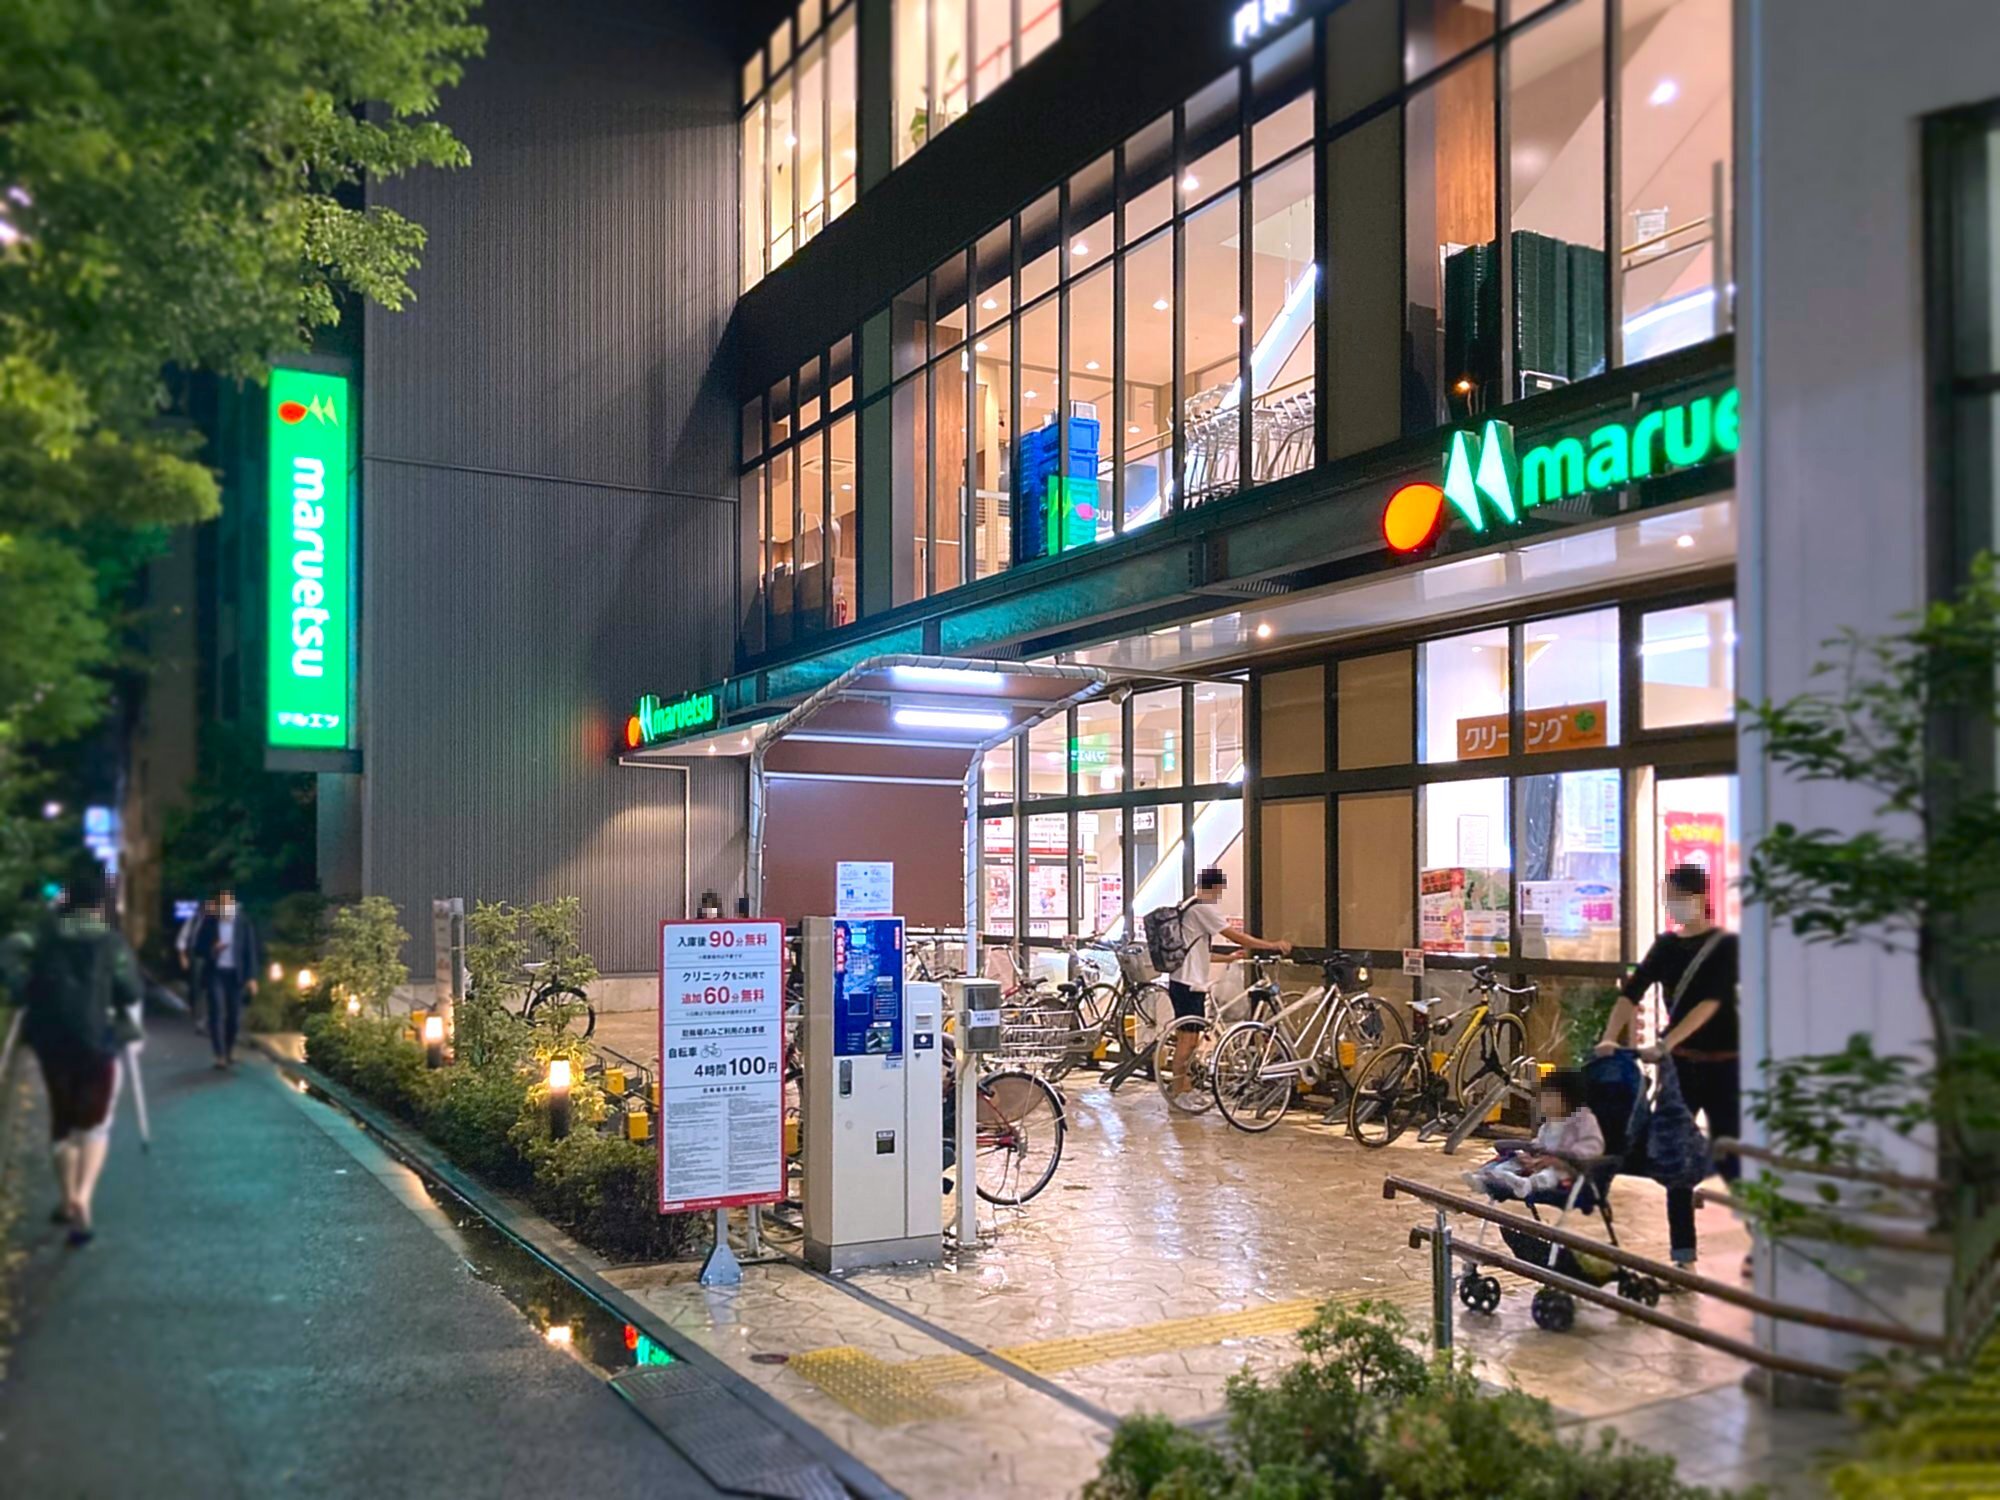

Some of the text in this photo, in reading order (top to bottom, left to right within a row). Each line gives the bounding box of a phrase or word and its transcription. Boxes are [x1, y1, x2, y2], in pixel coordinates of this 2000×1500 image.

[292, 456, 330, 678] maruetsu
[653, 693, 713, 735] maruetsu
[1464, 714, 1568, 751] クリーング
[682, 970, 766, 983] クリニックをご利用で
[668, 1046, 698, 1059] 自転車
